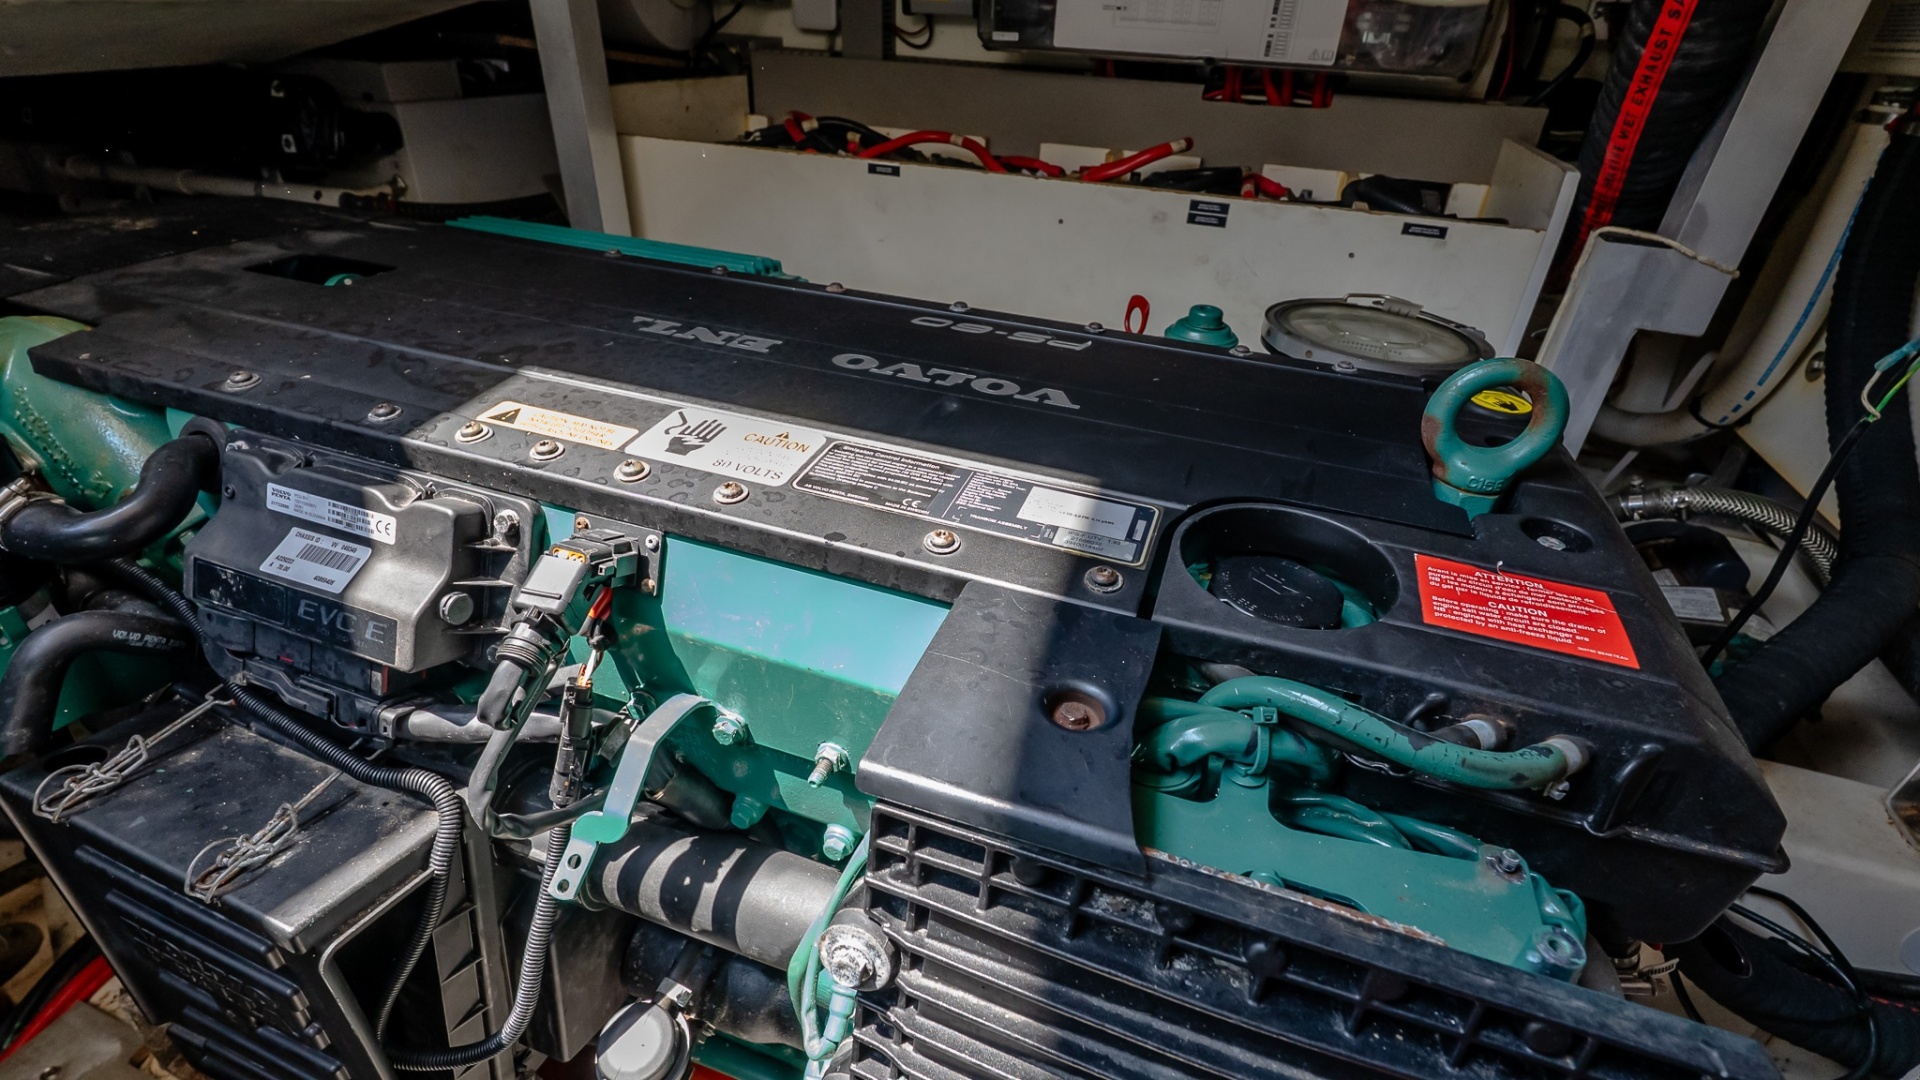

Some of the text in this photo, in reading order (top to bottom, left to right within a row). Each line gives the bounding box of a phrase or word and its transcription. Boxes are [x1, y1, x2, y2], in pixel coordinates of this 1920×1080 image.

[1631, 27, 1672, 106] EXHAUST
[829, 348, 1082, 409] VOLVO
[743, 432, 811, 453] CAUTION
[733, 462, 783, 480] VOLTS
[270, 491, 291, 501] PENTA
[374, 519, 392, 535] CE
[996, 520, 1028, 530] ASSEMBLY
[294, 531, 315, 541] CHASSIS
[1428, 571, 1454, 581] purges
[1474, 570, 1544, 589] ATTENTION
[1461, 582, 1492, 593] moteurs
[1479, 591, 1506, 601] liquide
[1432, 595, 1458, 605] Before
[1460, 601, 1498, 614] operating
[1568, 622, 1595, 632] drains
[1432, 600, 1459, 610] engine
[1548, 623, 1579, 634] closed.
[1487, 600, 1547, 618] CAUTION
[295, 598, 388, 643] EVC E
[1434, 611, 1472, 624] protected
[1501, 625, 1544, 638] anti-freeze
[1547, 634, 1574, 645] liquid.
[1453, 610, 1482, 621] engines
[1527, 625, 1572, 639] exchanger
[111, 629, 141, 641] VOLVO
[142, 634, 167, 644] PENTA
